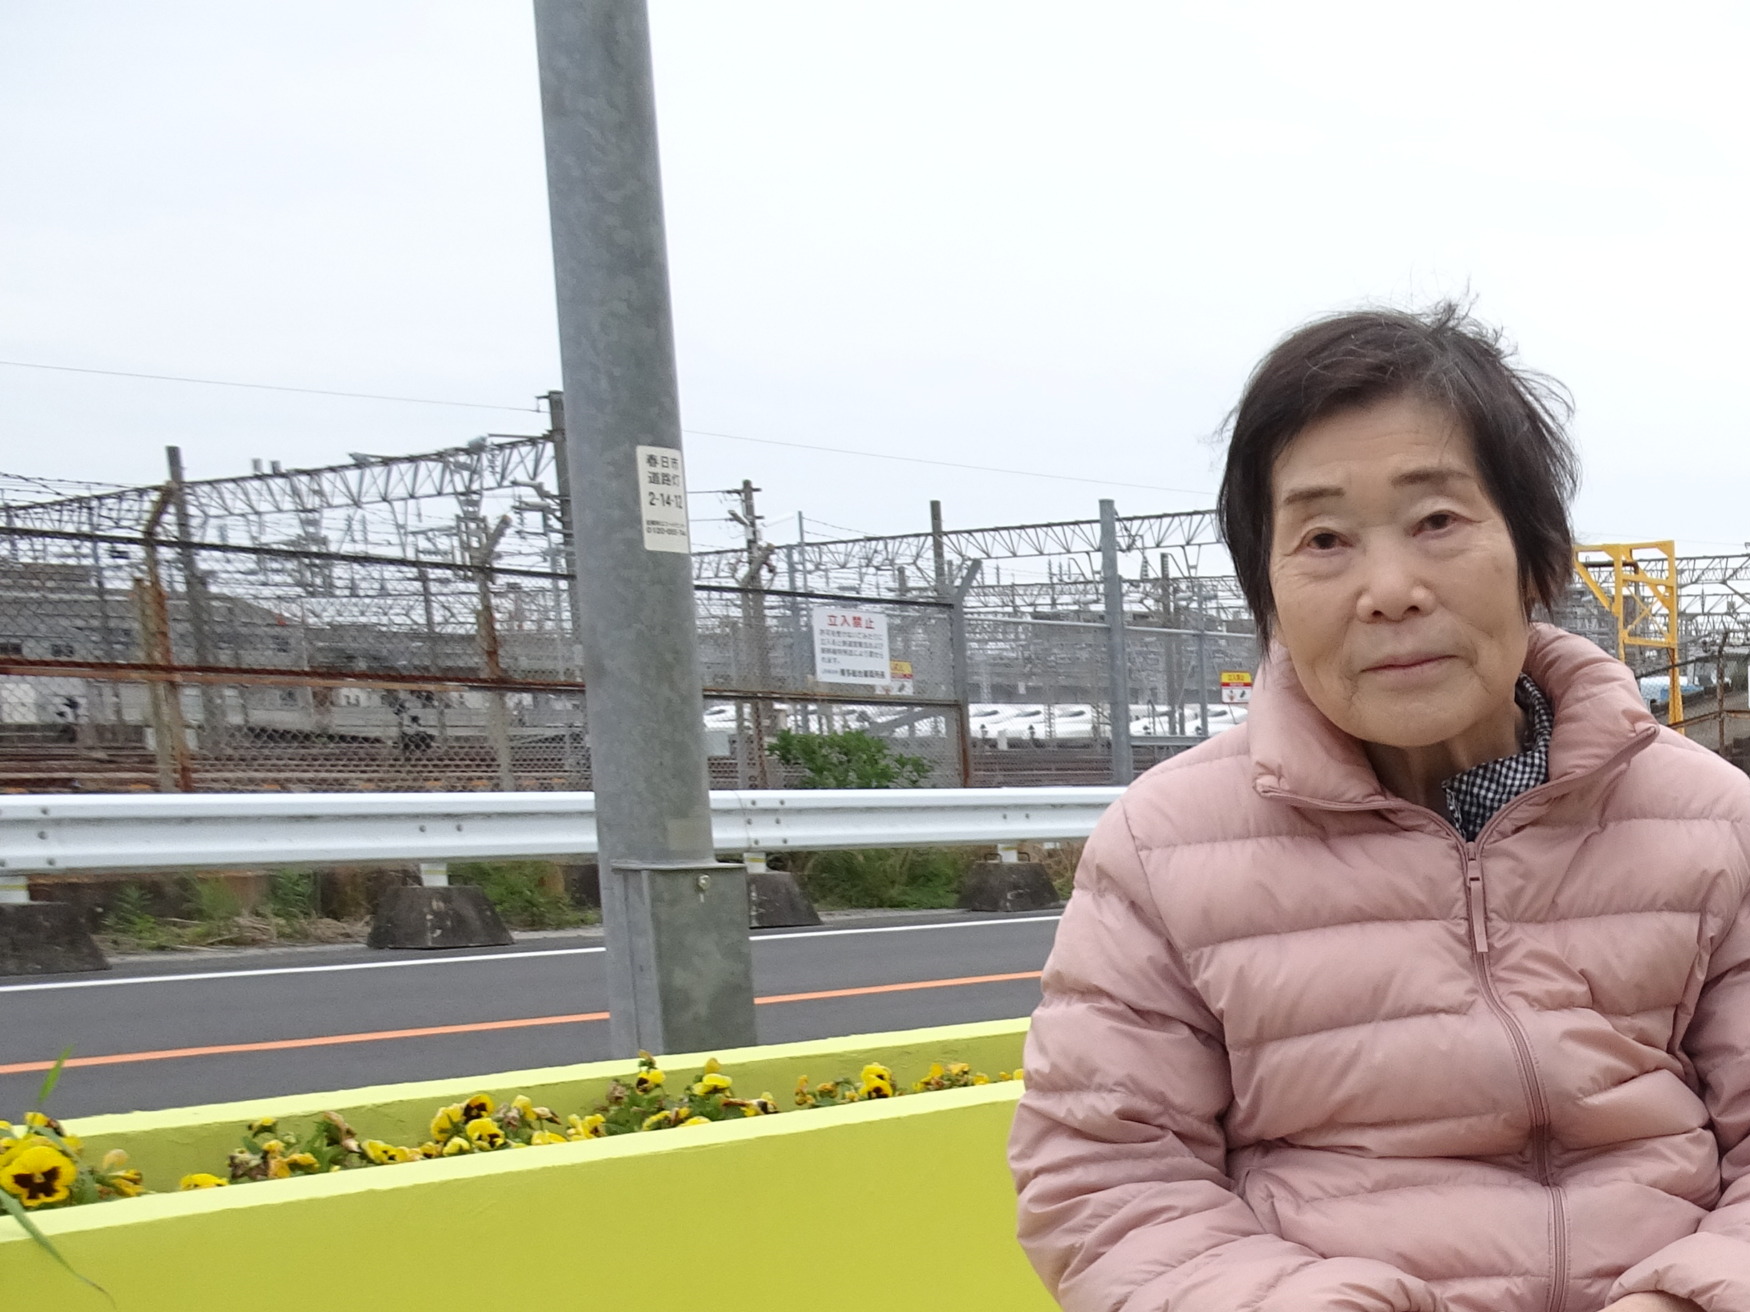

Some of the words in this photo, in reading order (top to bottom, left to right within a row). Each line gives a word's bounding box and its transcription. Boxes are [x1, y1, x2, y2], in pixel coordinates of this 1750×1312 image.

[646, 454, 679, 470] 春日市
[648, 491, 683, 509] 2-14-12
[827, 614, 875, 630] 立入禁止
